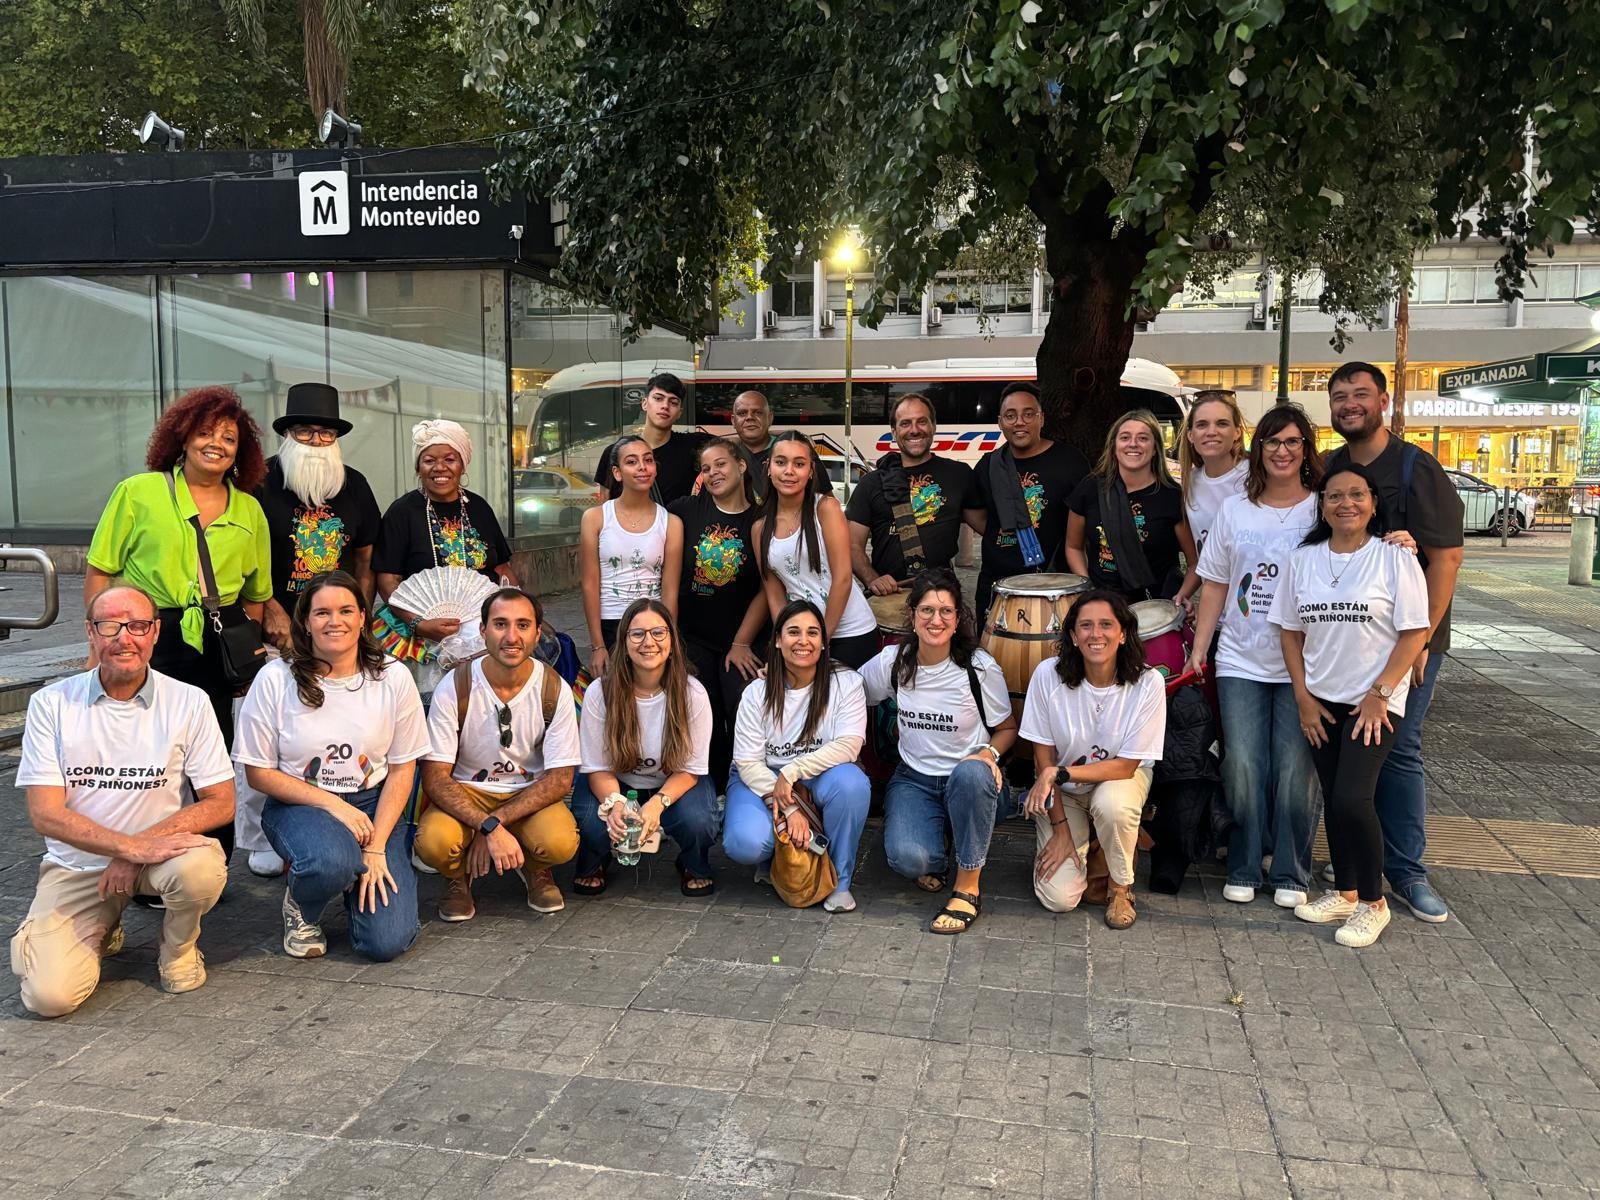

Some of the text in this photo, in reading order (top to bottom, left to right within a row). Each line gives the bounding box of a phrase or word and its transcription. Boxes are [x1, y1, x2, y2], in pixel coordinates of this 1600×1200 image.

[361, 179, 478, 202] Intendencia
[361, 204, 480, 227] Montevideo
[1446, 364, 1527, 388] EXPLANADA
[1413, 400, 1489, 416] PARRILLA
[1257, 563, 1279, 579] 20
[1331, 601, 1369, 612] ESTÁN
[1301, 612, 1373, 624] TUS RIÑONES?
[919, 712, 954, 723] ESTÁN
[907, 720, 959, 732] RIÑONES?
[326, 743, 353, 764] 20
[66, 765, 166, 777] ¿COMO ESTÁN
[492, 761, 515, 775] 20
[70, 778, 168, 790] TUS RIÑONES?
